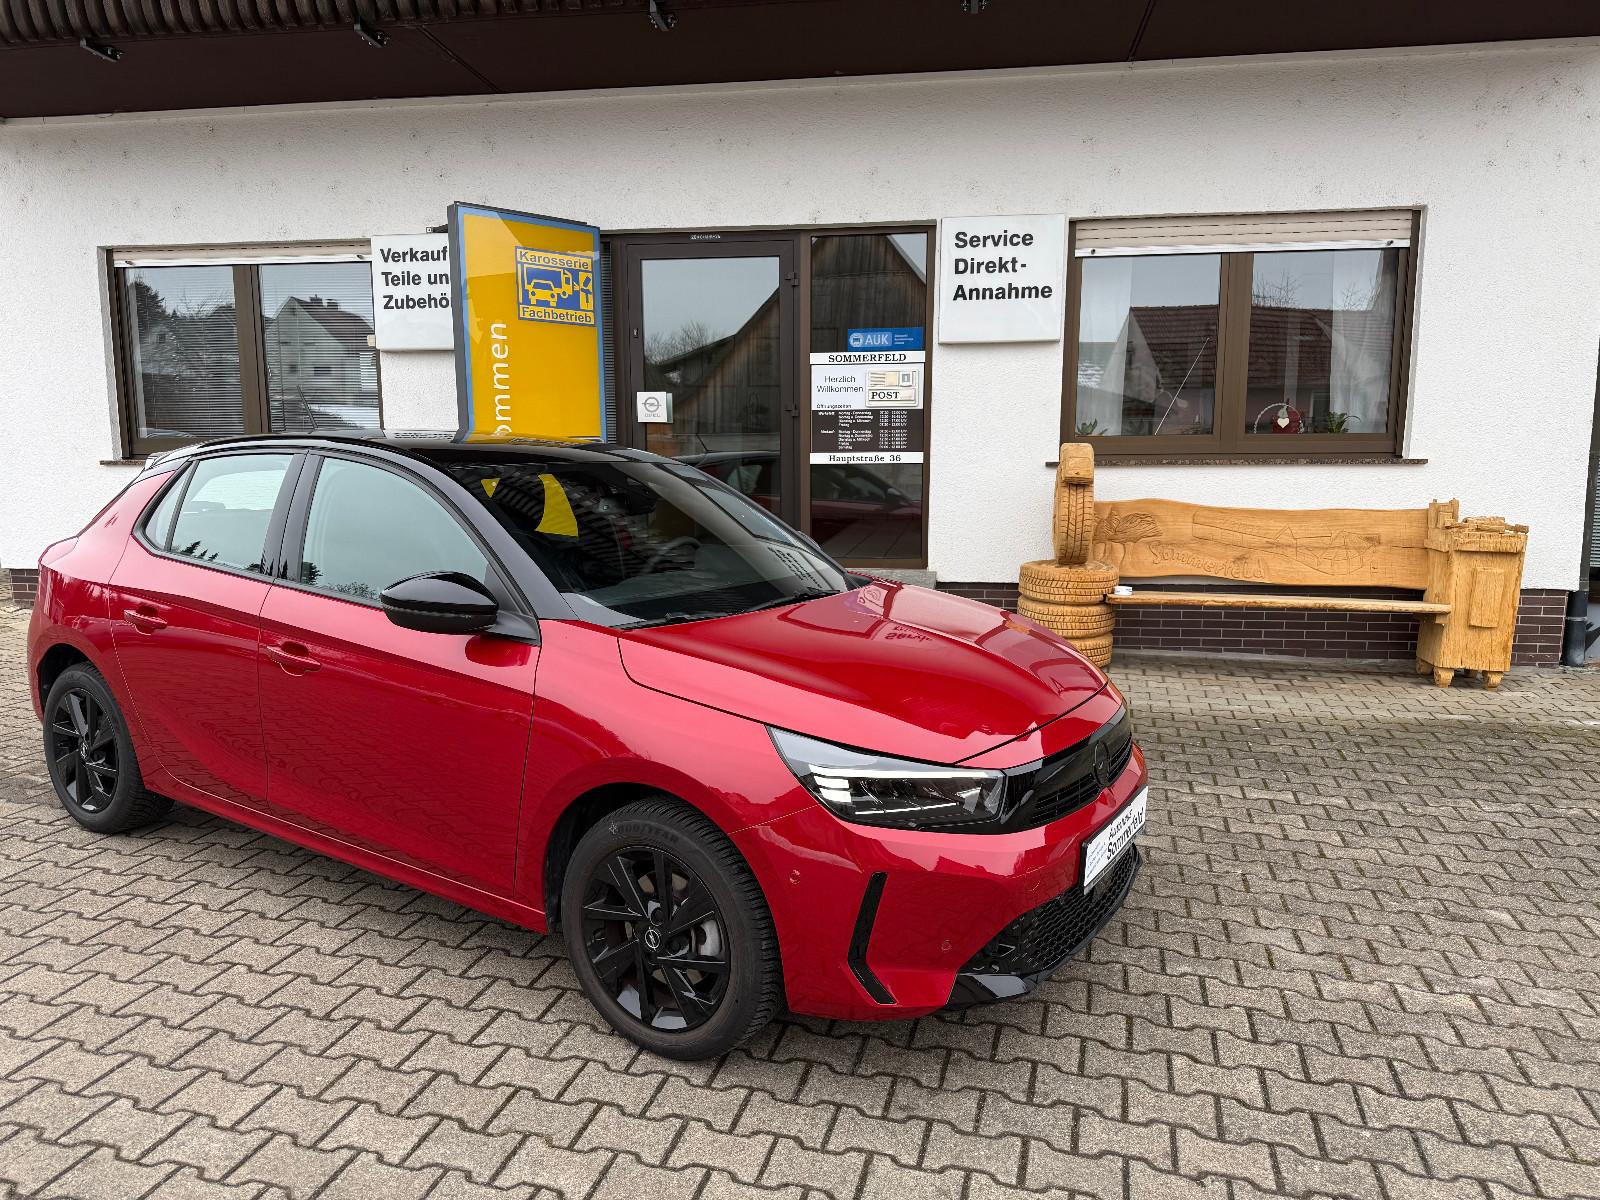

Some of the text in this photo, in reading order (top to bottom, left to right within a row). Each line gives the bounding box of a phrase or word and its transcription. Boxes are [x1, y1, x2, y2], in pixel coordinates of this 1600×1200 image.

[954, 230, 1034, 249] Service
[379, 246, 448, 263] Verkauf
[518, 250, 590, 271] Karosserie
[954, 257, 1027, 275] Direkt-
[381, 271, 422, 287] Teile
[952, 283, 1053, 301] Annahme
[383, 292, 450, 310] Zubehö
[521, 306, 593, 324] Fachbetrieb
[864, 333, 889, 345] AUK
[828, 353, 907, 363] SOMMERFELD
[824, 375, 856, 383] Herzlich
[816, 385, 864, 393] Willkommen
[871, 391, 900, 400] POST
[829, 454, 902, 463] Hauptstraße 36
[1148, 540, 1267, 580] Sommerfeld
